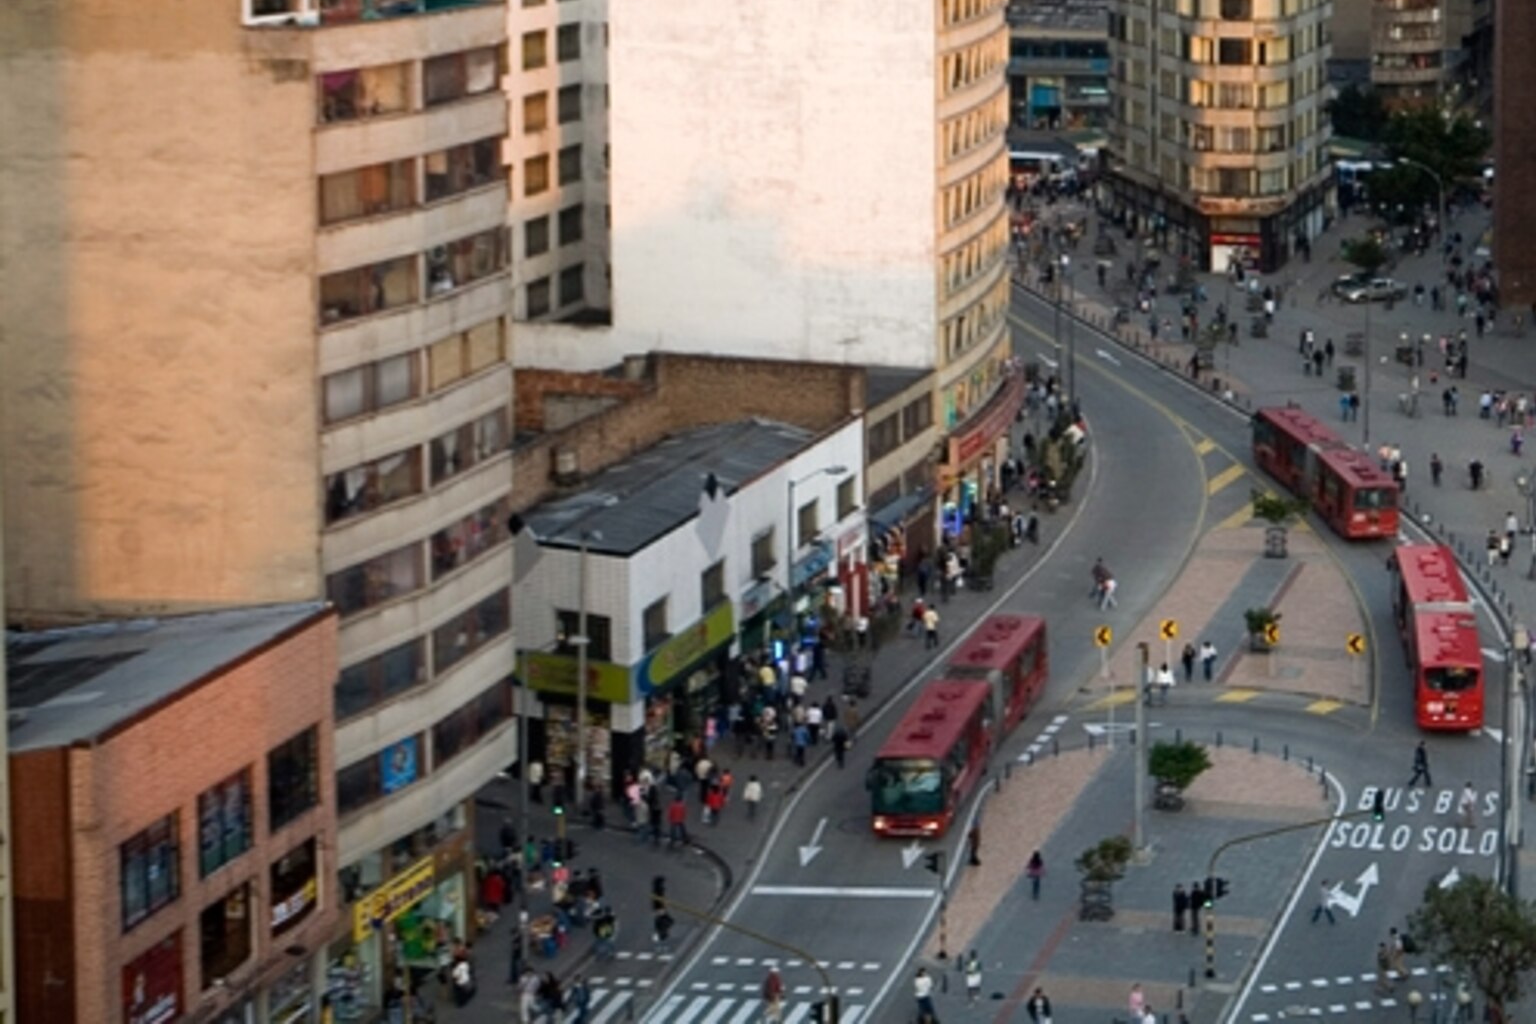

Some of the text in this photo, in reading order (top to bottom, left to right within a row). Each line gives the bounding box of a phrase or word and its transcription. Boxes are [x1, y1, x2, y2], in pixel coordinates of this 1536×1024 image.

[1358, 787, 1424, 813] BUS
[1331, 822, 1499, 855] SOLO SOLO
